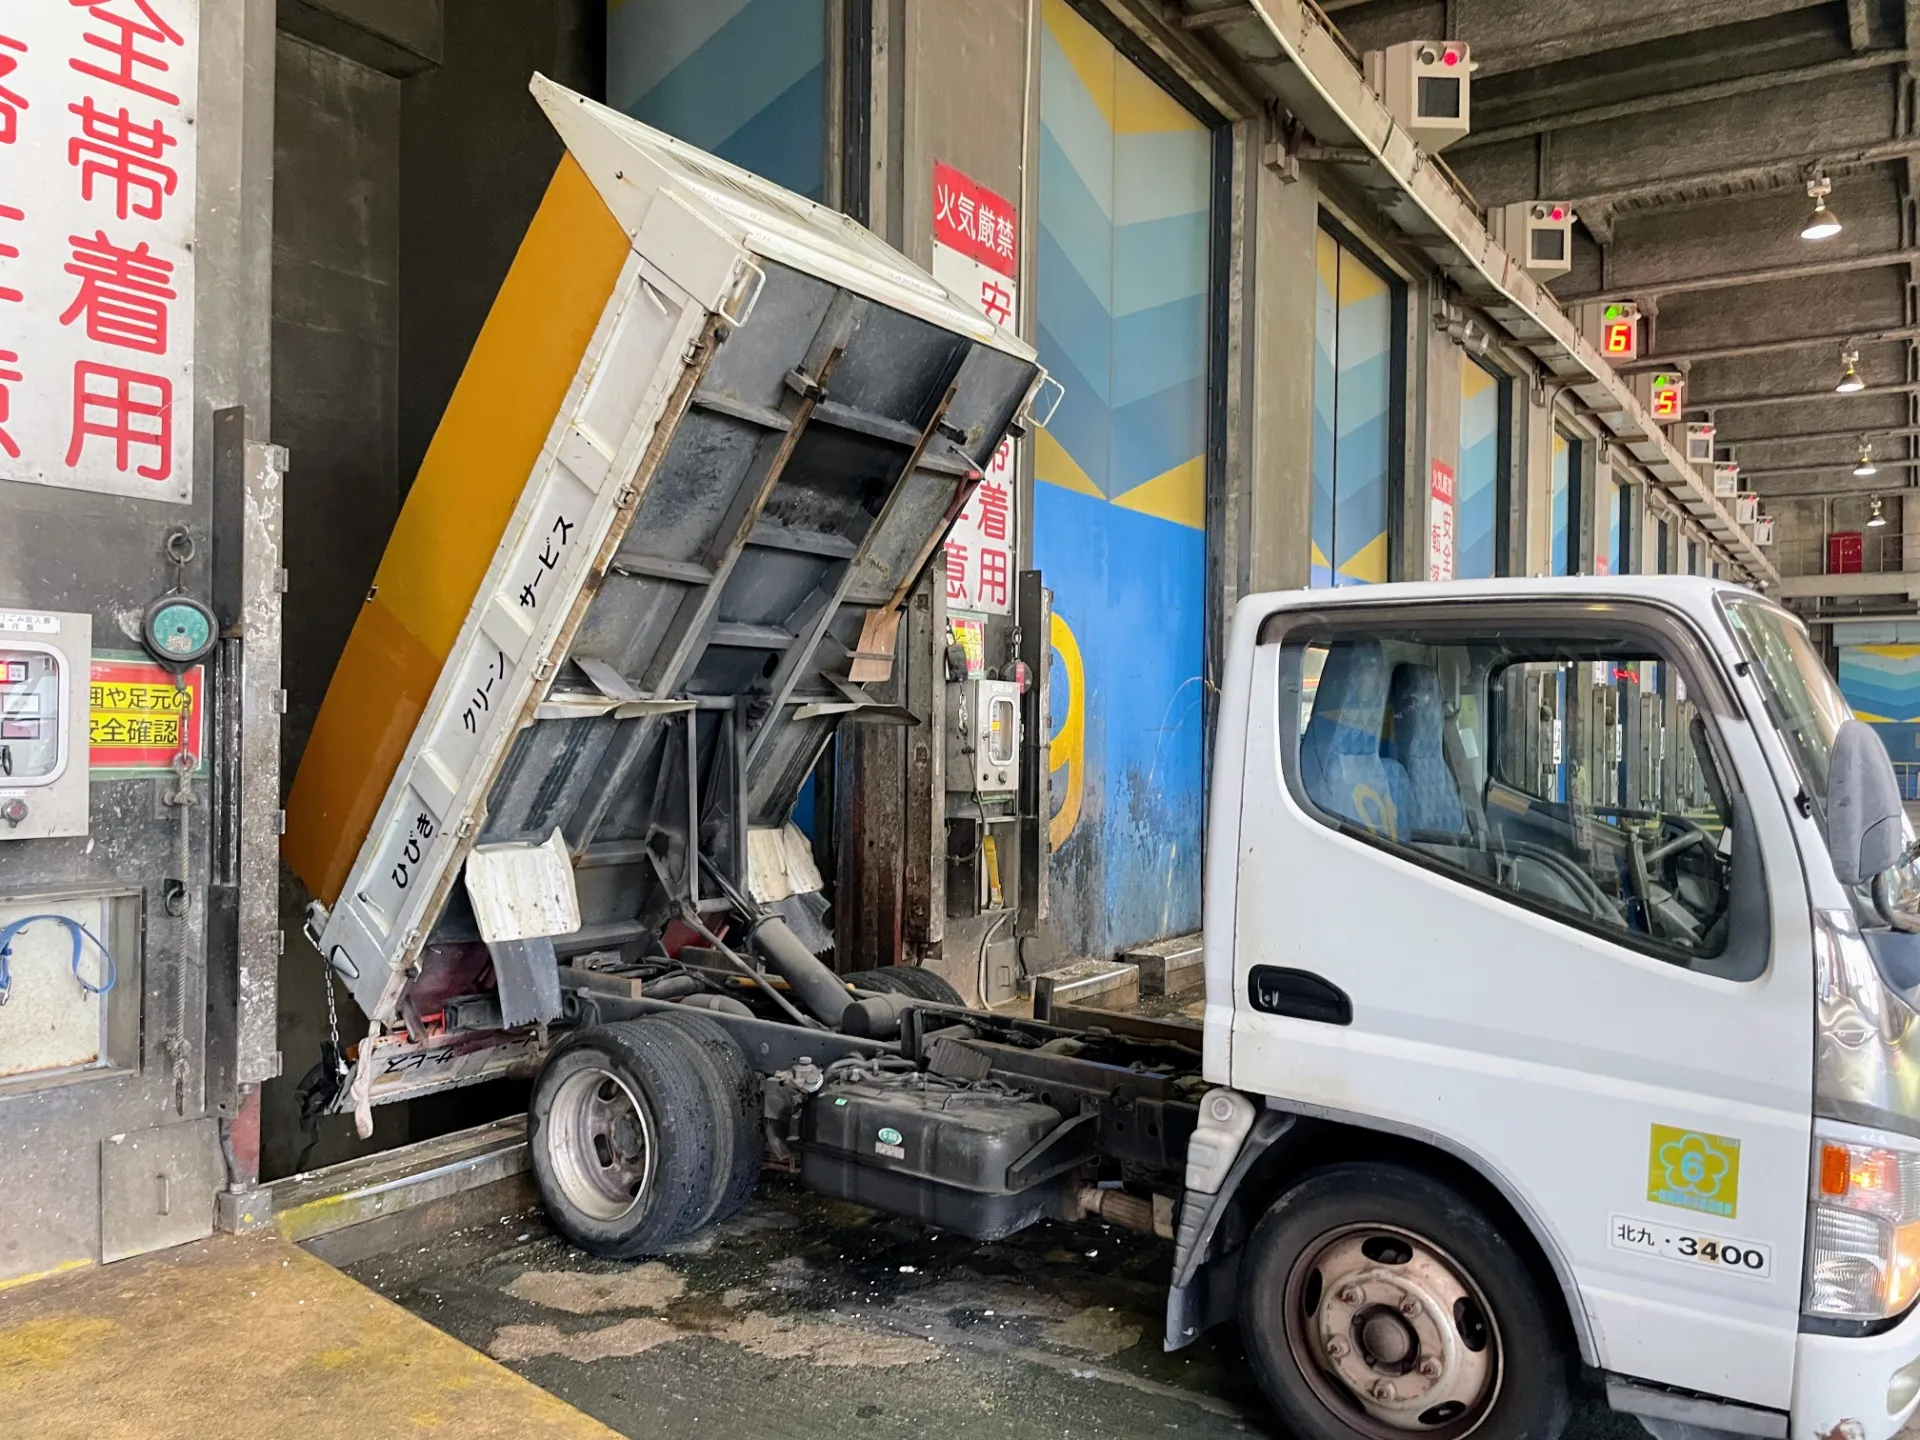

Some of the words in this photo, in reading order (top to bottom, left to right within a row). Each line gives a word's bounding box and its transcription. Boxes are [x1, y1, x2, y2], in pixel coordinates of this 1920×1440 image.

[936, 183, 1015, 261] 火気厳禁
[1608, 323, 1628, 352] 6
[1657, 391, 1674, 414] 5
[391, 812, 434, 889] ひびき
[463, 651, 507, 734] クリーン
[520, 515, 575, 608] サービス
[1681, 1151, 1704, 1182] 6
